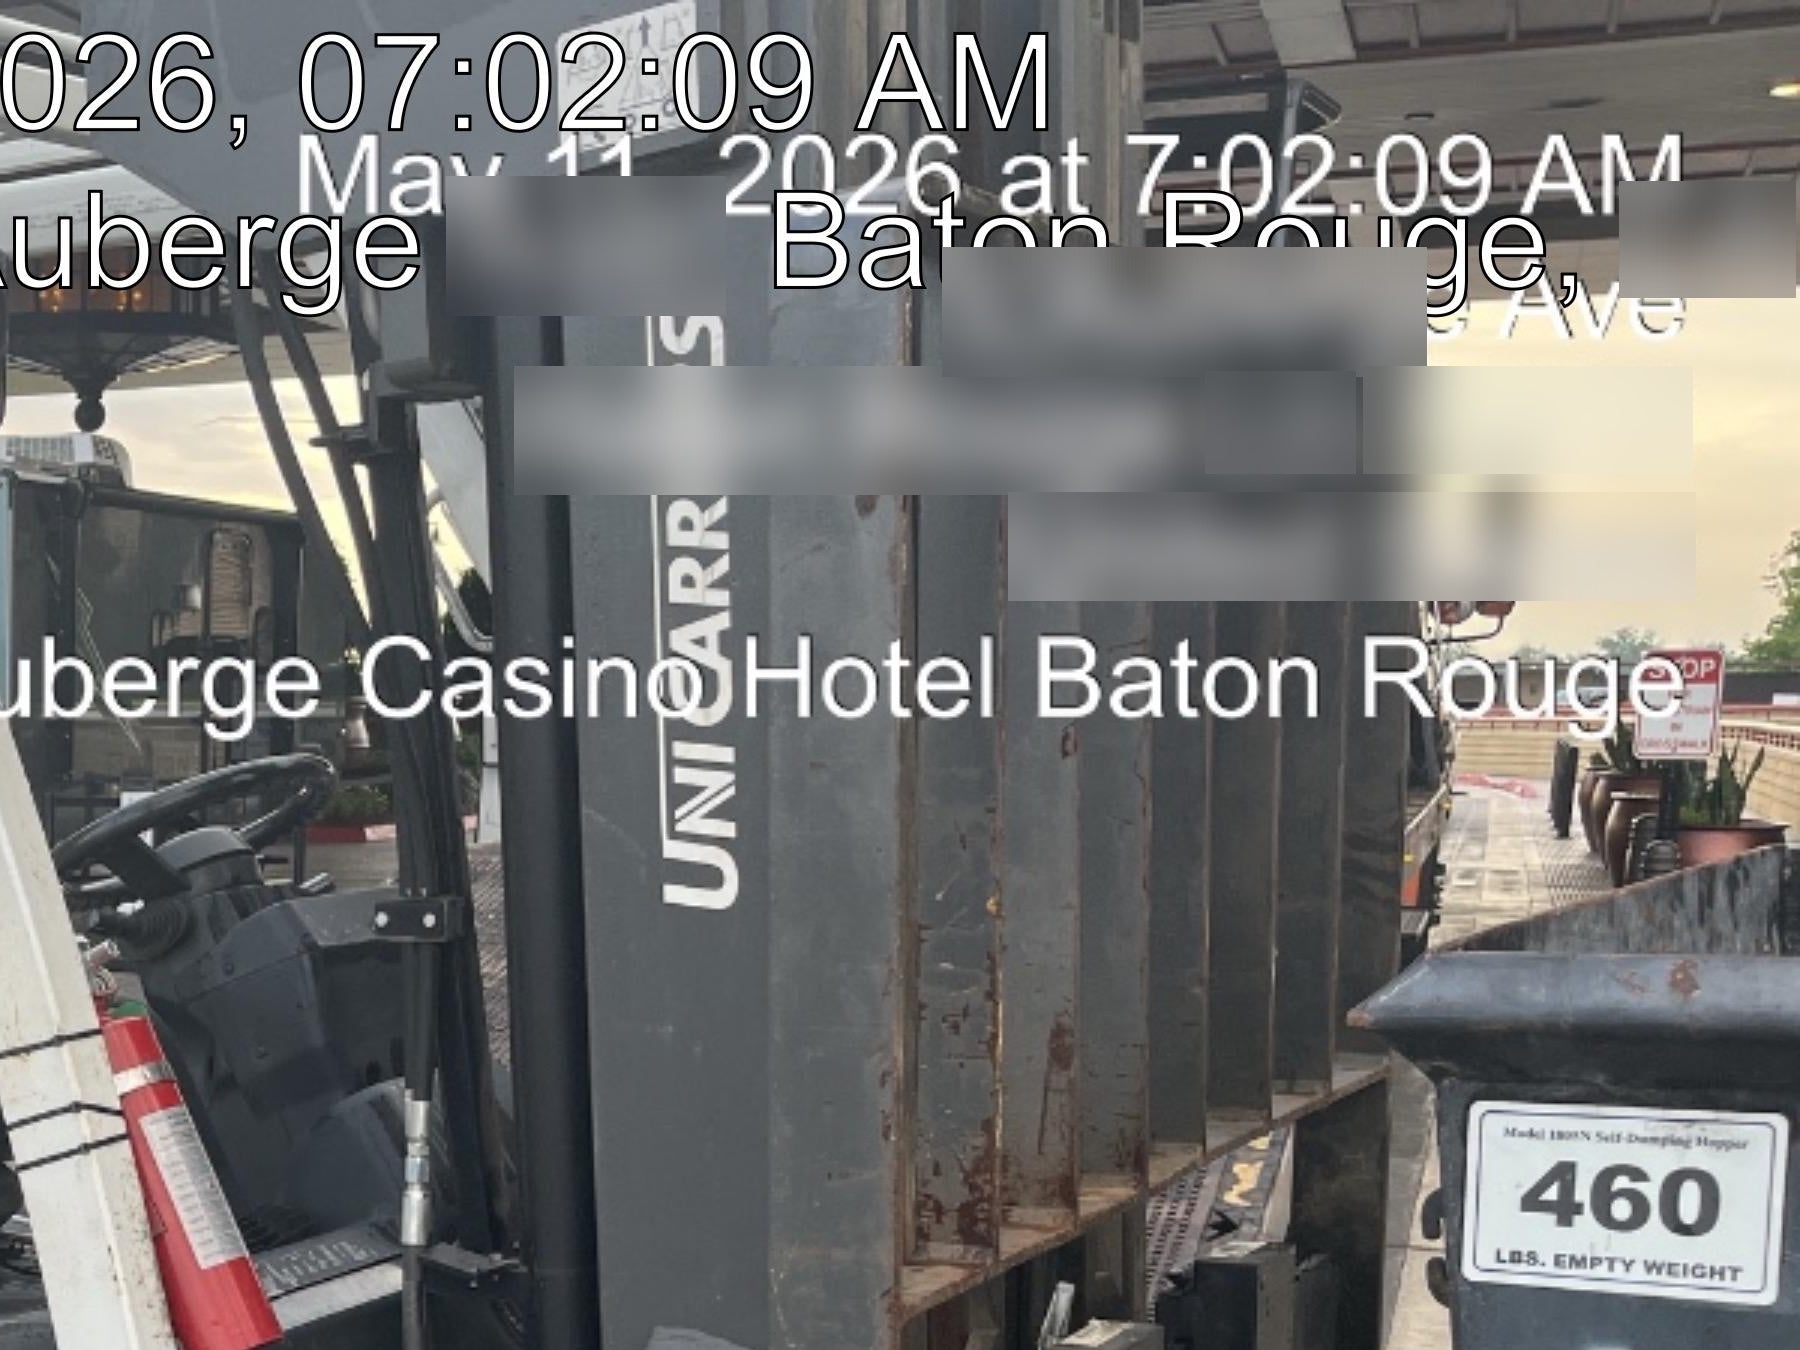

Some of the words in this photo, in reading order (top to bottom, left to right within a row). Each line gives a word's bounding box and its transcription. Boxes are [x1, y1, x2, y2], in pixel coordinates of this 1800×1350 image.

[1648, 656, 1716, 680] SOP
[1519, 1160, 1721, 1237] 460
[1495, 1248, 1546, 1267] LBS.
[1553, 1253, 1636, 1273] EMPTY
[1643, 1259, 1744, 1282] WEIGHT
